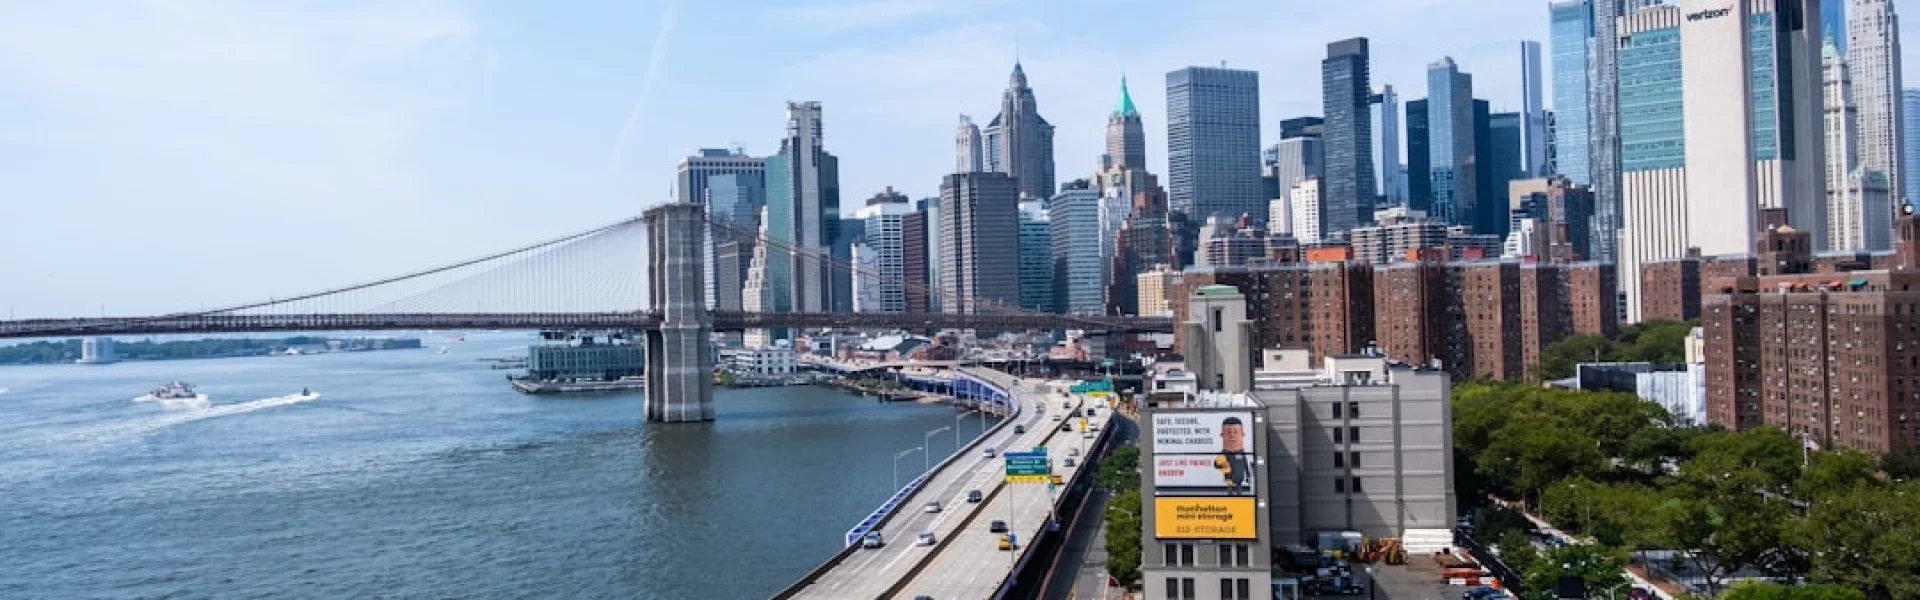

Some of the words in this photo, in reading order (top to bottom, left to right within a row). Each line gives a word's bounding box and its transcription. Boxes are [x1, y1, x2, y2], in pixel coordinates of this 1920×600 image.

[1686, 8, 1729, 21] verizon
[1158, 469, 1185, 477] ANDREW
[1176, 502, 1228, 512] manhattan
[1197, 513, 1233, 522] storage
